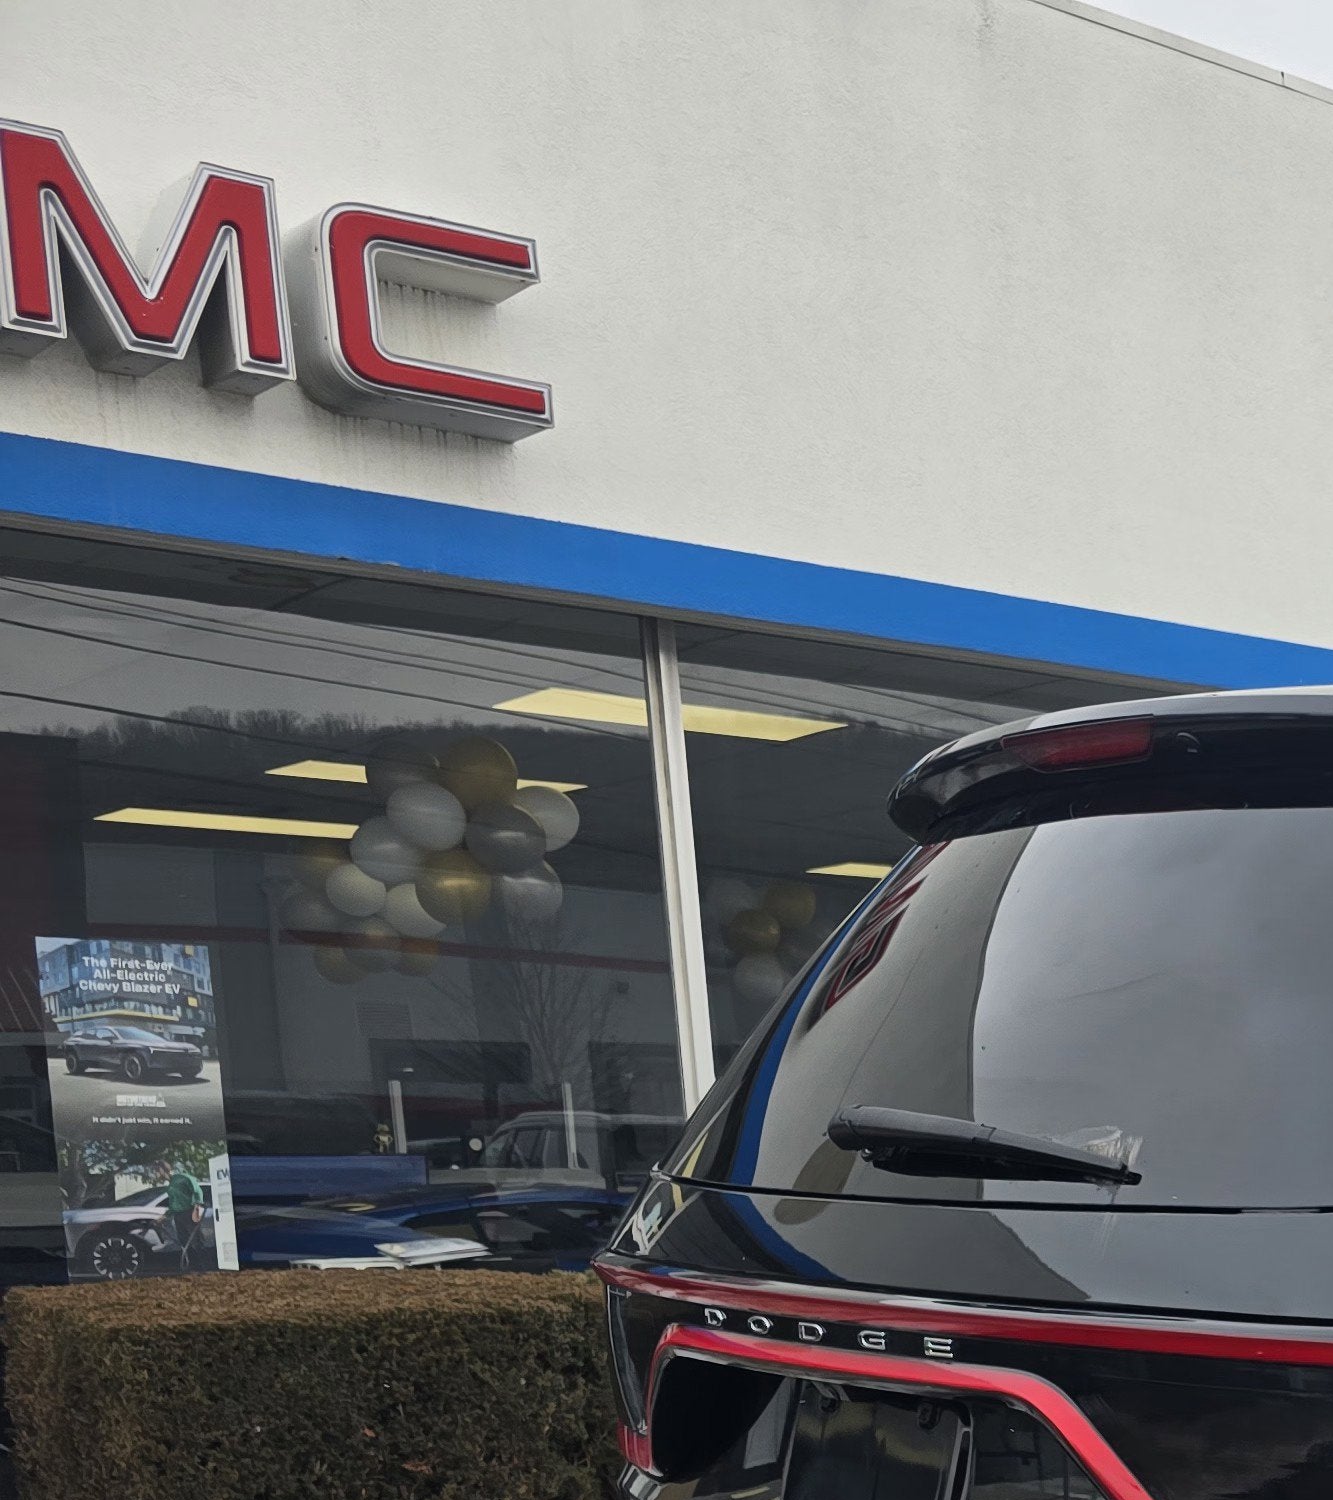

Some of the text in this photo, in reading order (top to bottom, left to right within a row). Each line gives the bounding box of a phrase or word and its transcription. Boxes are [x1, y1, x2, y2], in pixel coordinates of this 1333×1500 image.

[82, 956, 173, 971] The First-Ever
[93, 968, 166, 982] All-Electric
[79, 979, 180, 994] Chevy Blazer EV
[704, 1307, 953, 1359] DODGE
